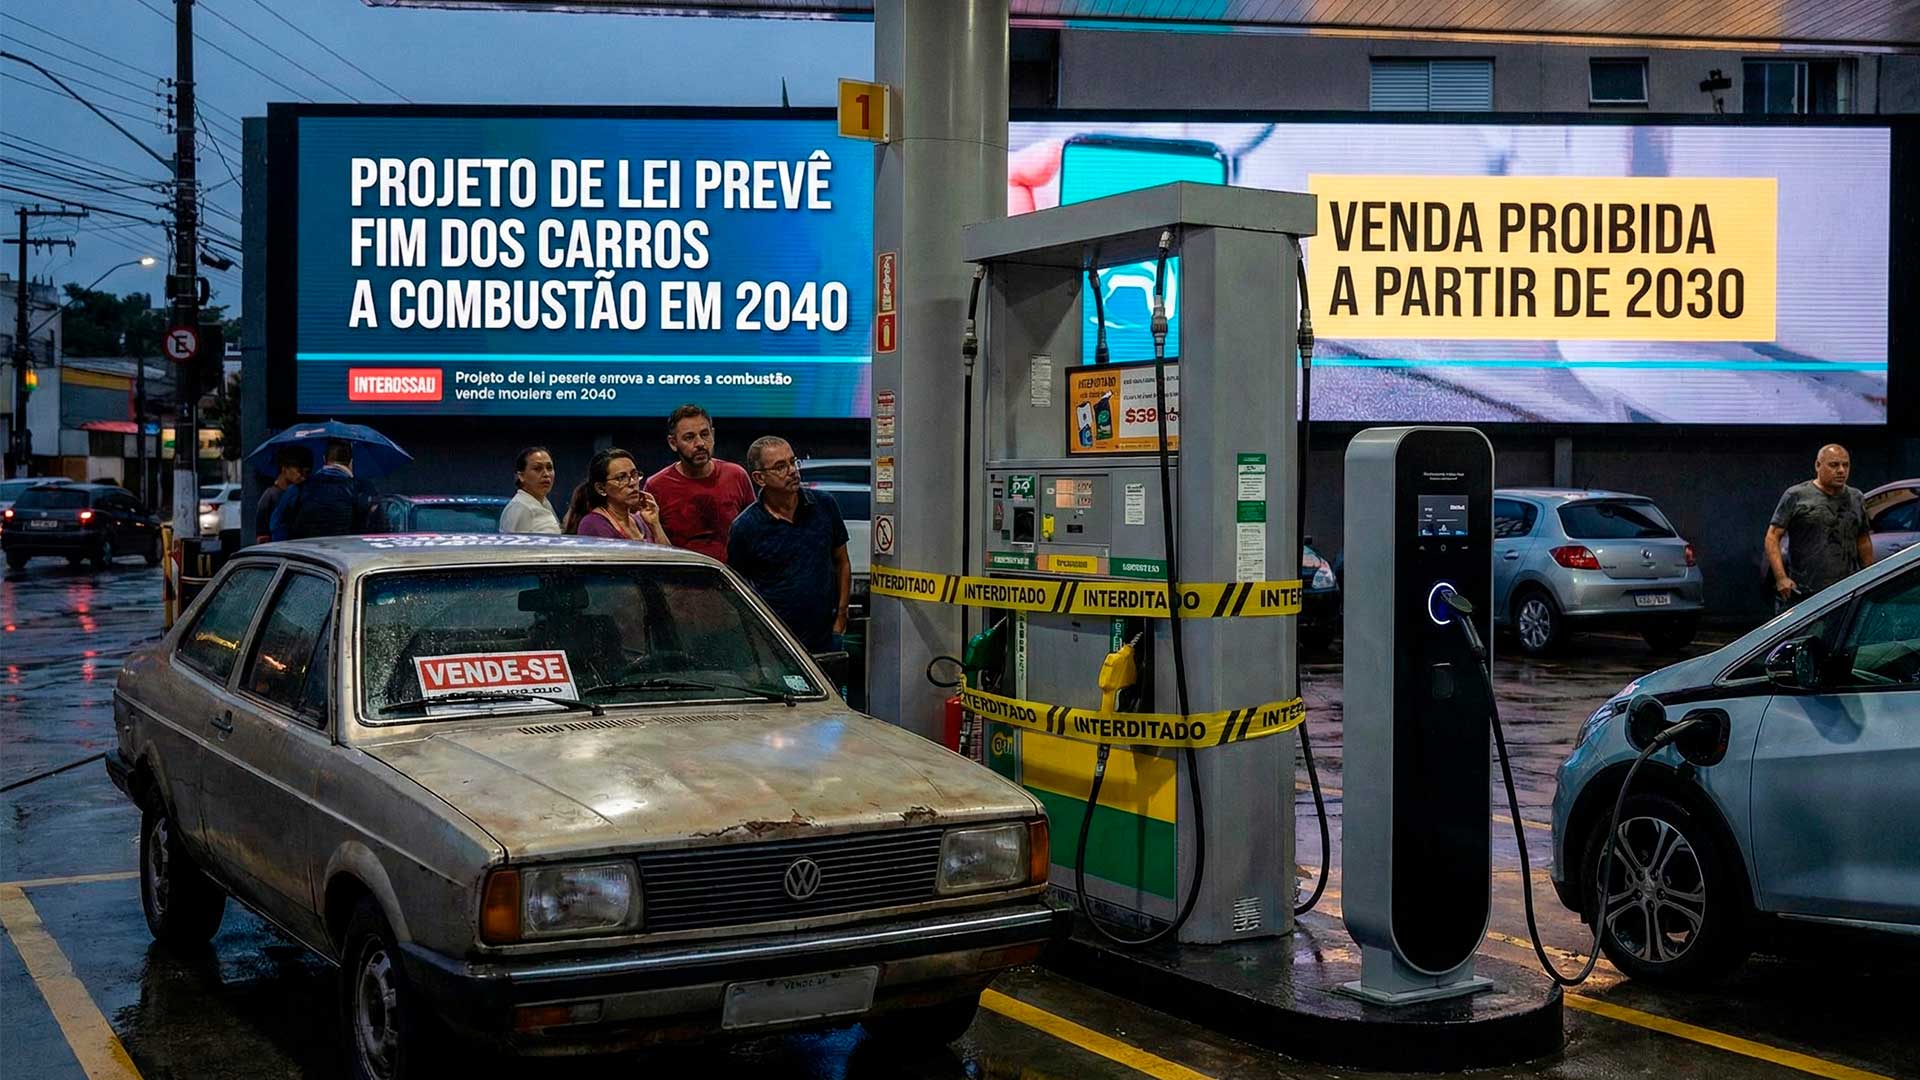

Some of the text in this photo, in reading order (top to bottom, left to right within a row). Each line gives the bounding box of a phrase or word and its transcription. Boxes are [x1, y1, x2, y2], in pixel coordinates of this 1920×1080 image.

[855, 94, 870, 130] 1
[352, 149, 832, 209] PROJETO DE LEI PREVÊ
[352, 218, 709, 269] FIM DOS CARROS
[1329, 201, 1716, 254] VENDA PROIBIDA
[349, 279, 378, 327] A
[390, 269, 646, 330] COMBUSTÃO
[661, 281, 721, 330] EM
[736, 281, 848, 331] 2040
[1329, 266, 1744, 319] A PARTIR DE 2030
[455, 371, 505, 386] Projeto
[508, 371, 525, 384] de
[529, 371, 545, 384] lei
[647, 374, 655, 385] a
[658, 374, 701, 385] carros
[704, 374, 713, 385] a
[716, 373, 793, 386] combustão
[455, 387, 495, 399] vende
[556, 389, 577, 400] em
[580, 388, 617, 400] 2040
[964, 583, 1046, 605] INTERDITADO
[425, 658, 565, 686] VENDE-SE
[1074, 715, 1206, 741] INTERDITADO
